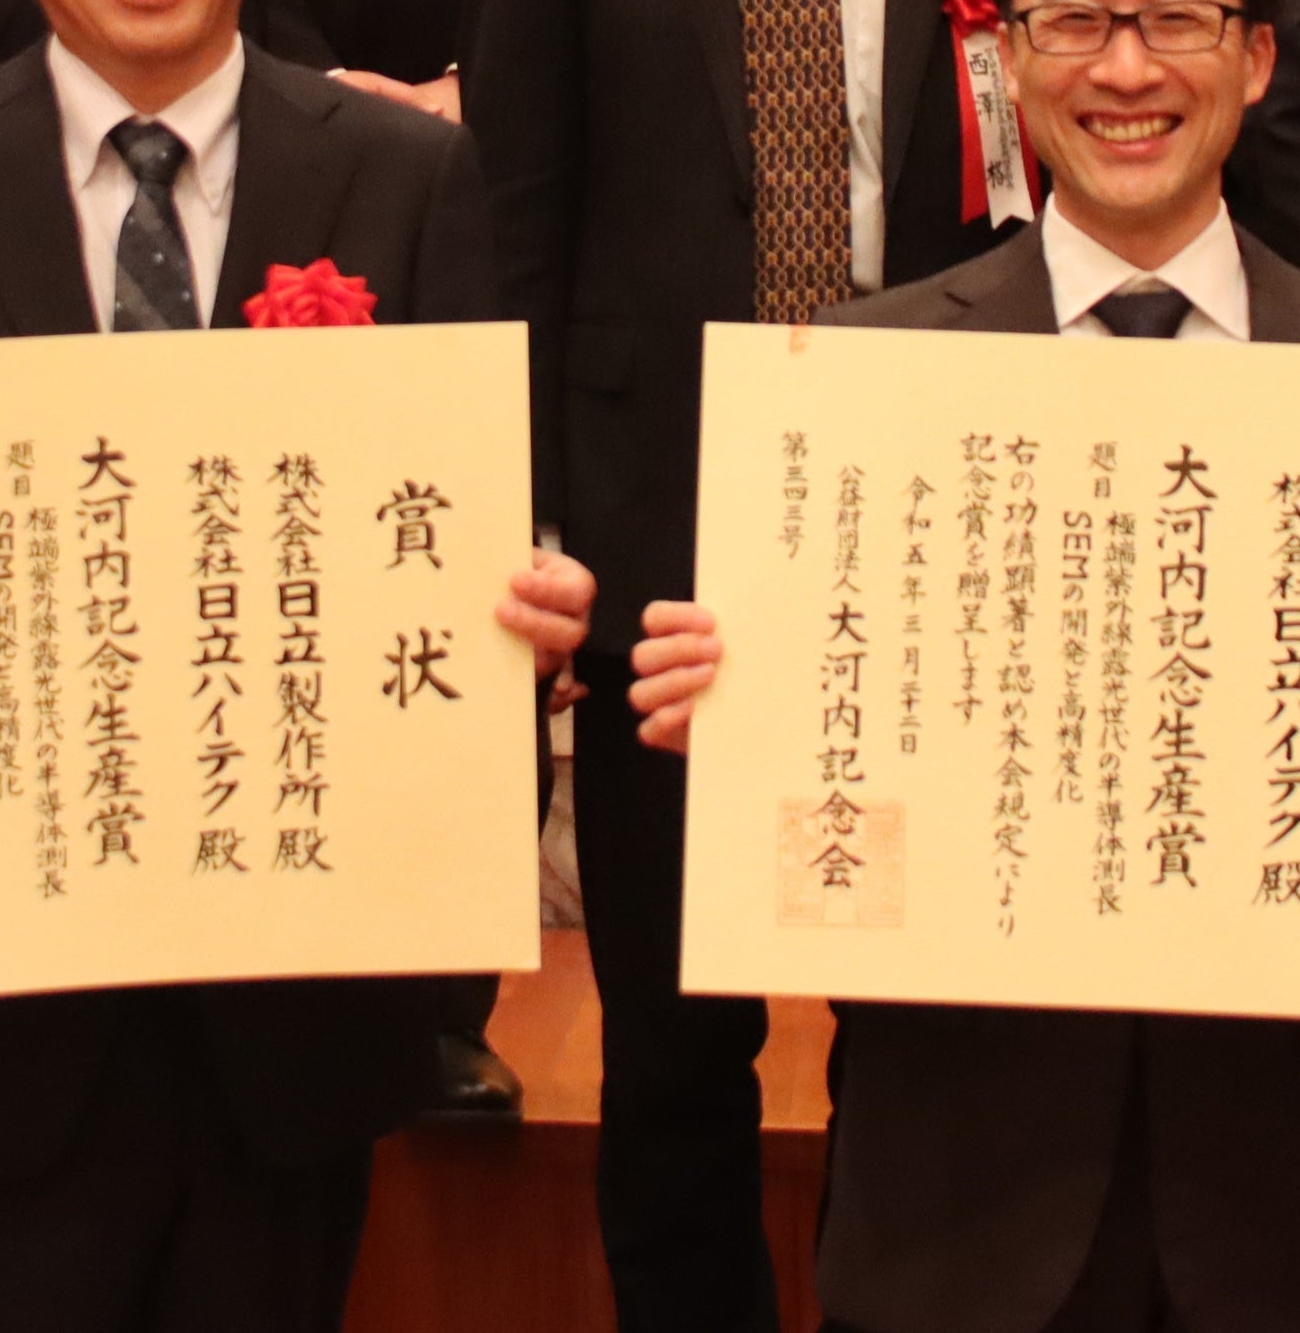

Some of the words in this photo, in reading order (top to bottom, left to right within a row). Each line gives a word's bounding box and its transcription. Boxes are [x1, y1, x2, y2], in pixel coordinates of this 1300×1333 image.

[75, 435, 146, 867] 大河内記念生産賞
[376, 478, 464, 711] 賞状
[1145, 443, 1218, 888] 大河内記念生産賞
